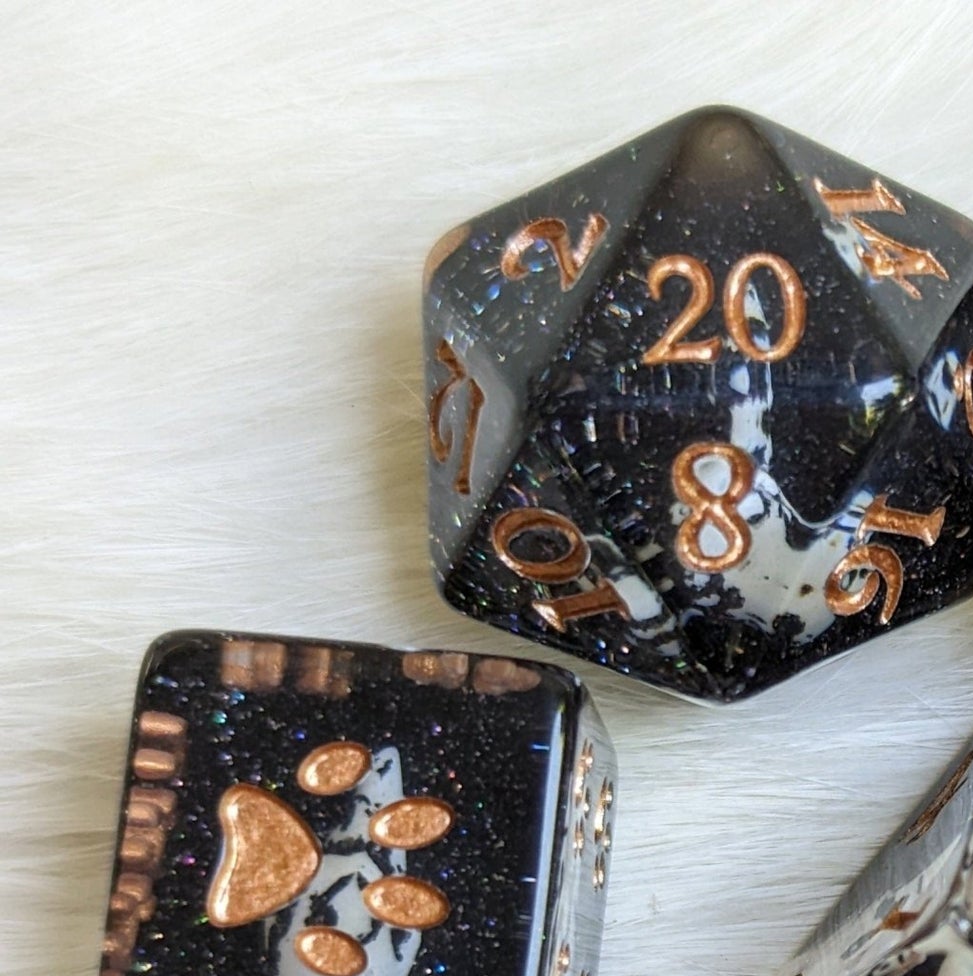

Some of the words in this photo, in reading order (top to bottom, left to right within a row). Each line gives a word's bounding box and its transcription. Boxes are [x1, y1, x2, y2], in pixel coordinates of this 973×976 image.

[501, 212, 608, 292] 2
[642, 252, 807, 364] 20
[491, 506, 631, 633] 10
[672, 442, 755, 573] 8
[823, 494, 946, 625] 16
